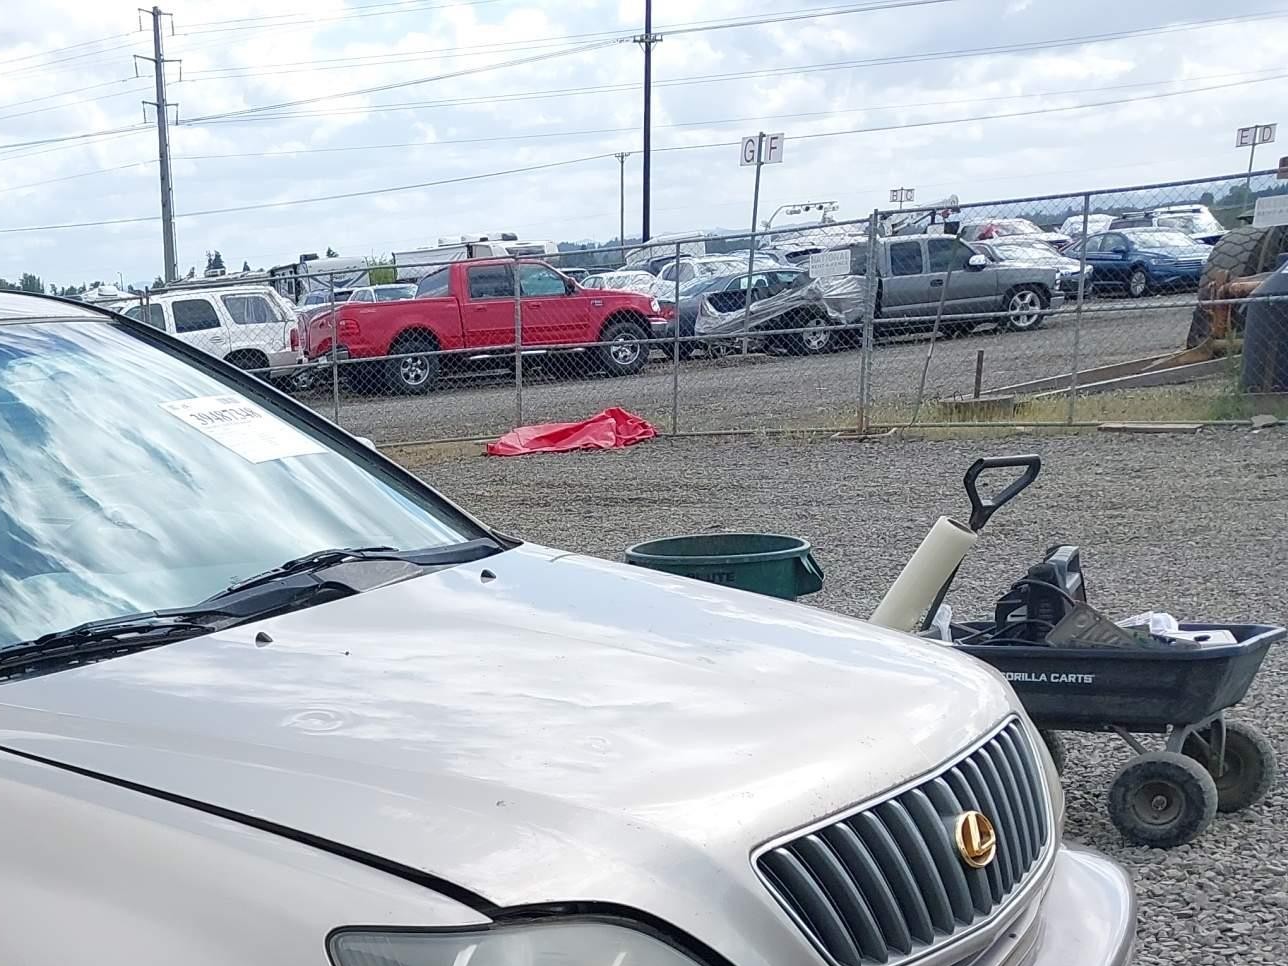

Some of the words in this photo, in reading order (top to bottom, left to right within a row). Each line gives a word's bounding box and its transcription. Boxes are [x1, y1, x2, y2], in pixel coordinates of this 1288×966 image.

[1240, 128, 1249, 145] E
[1263, 125, 1273, 141] D
[744, 138, 756, 163] G
[768, 136, 779, 161] F
[1049, 673, 1094, 684] CARTS
